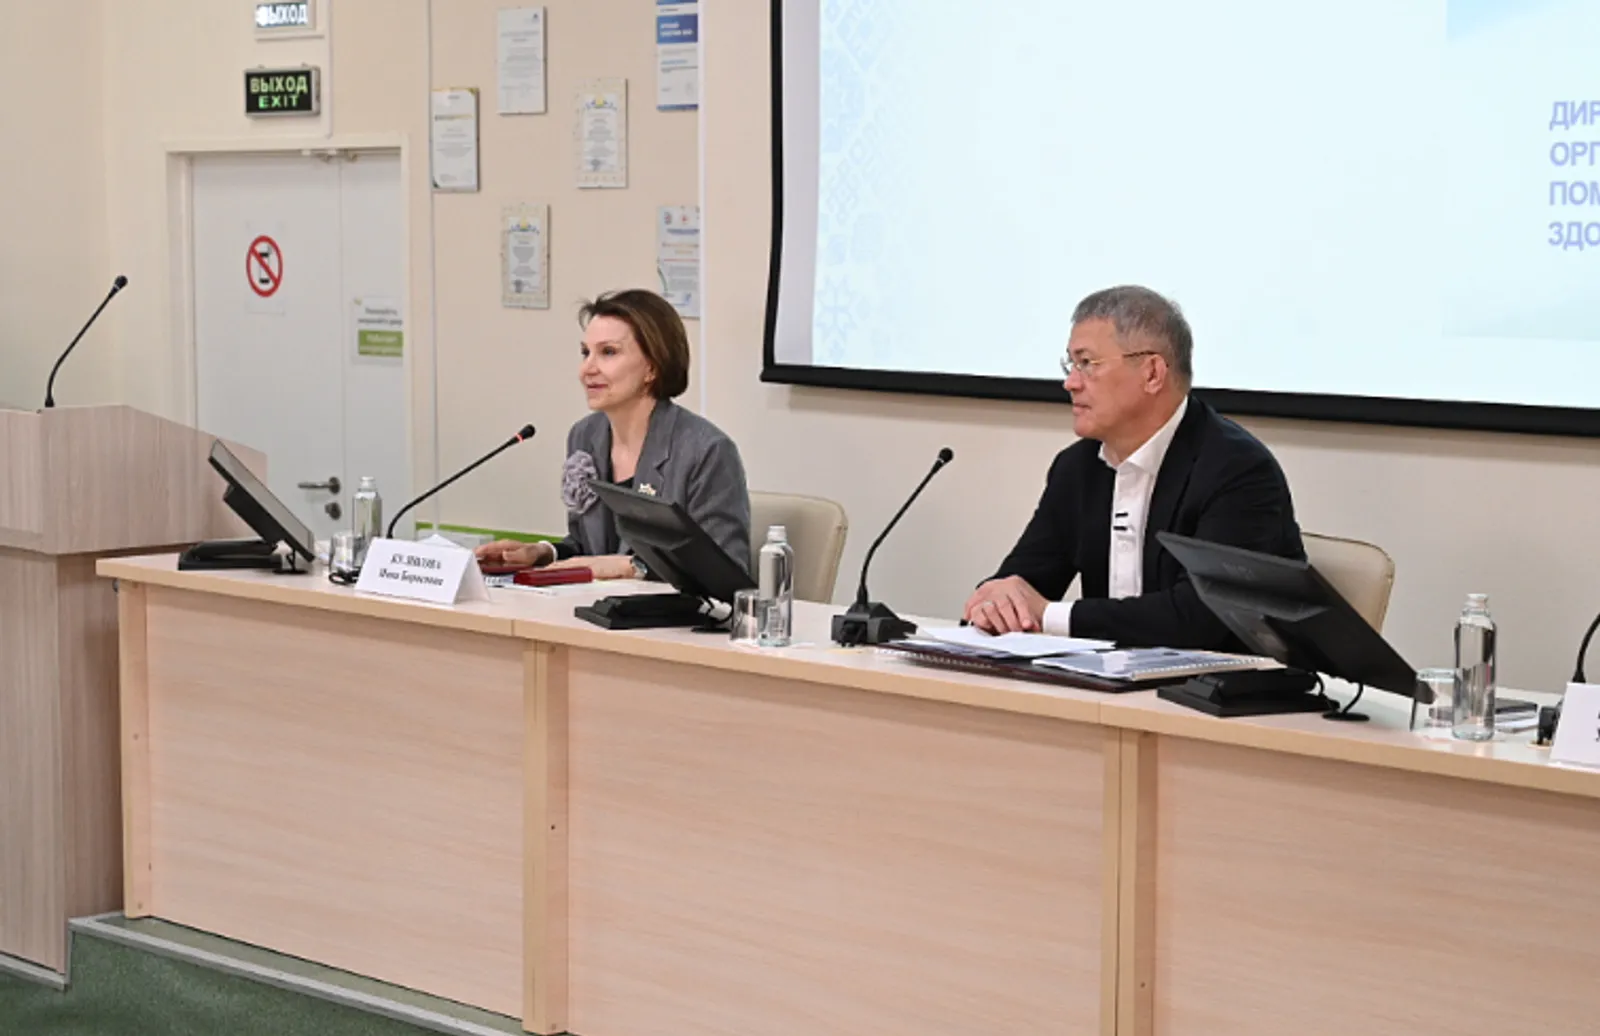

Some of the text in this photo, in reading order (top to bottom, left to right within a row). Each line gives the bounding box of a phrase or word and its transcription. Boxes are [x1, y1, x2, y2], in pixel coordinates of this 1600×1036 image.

[250, 75, 308, 94] ВЫХОД
[258, 95, 299, 109] EXIT
[1549, 100, 1600, 131] ДИР
[1549, 141, 1600, 166] ОРГ
[1548, 221, 1600, 251] ЗДО
